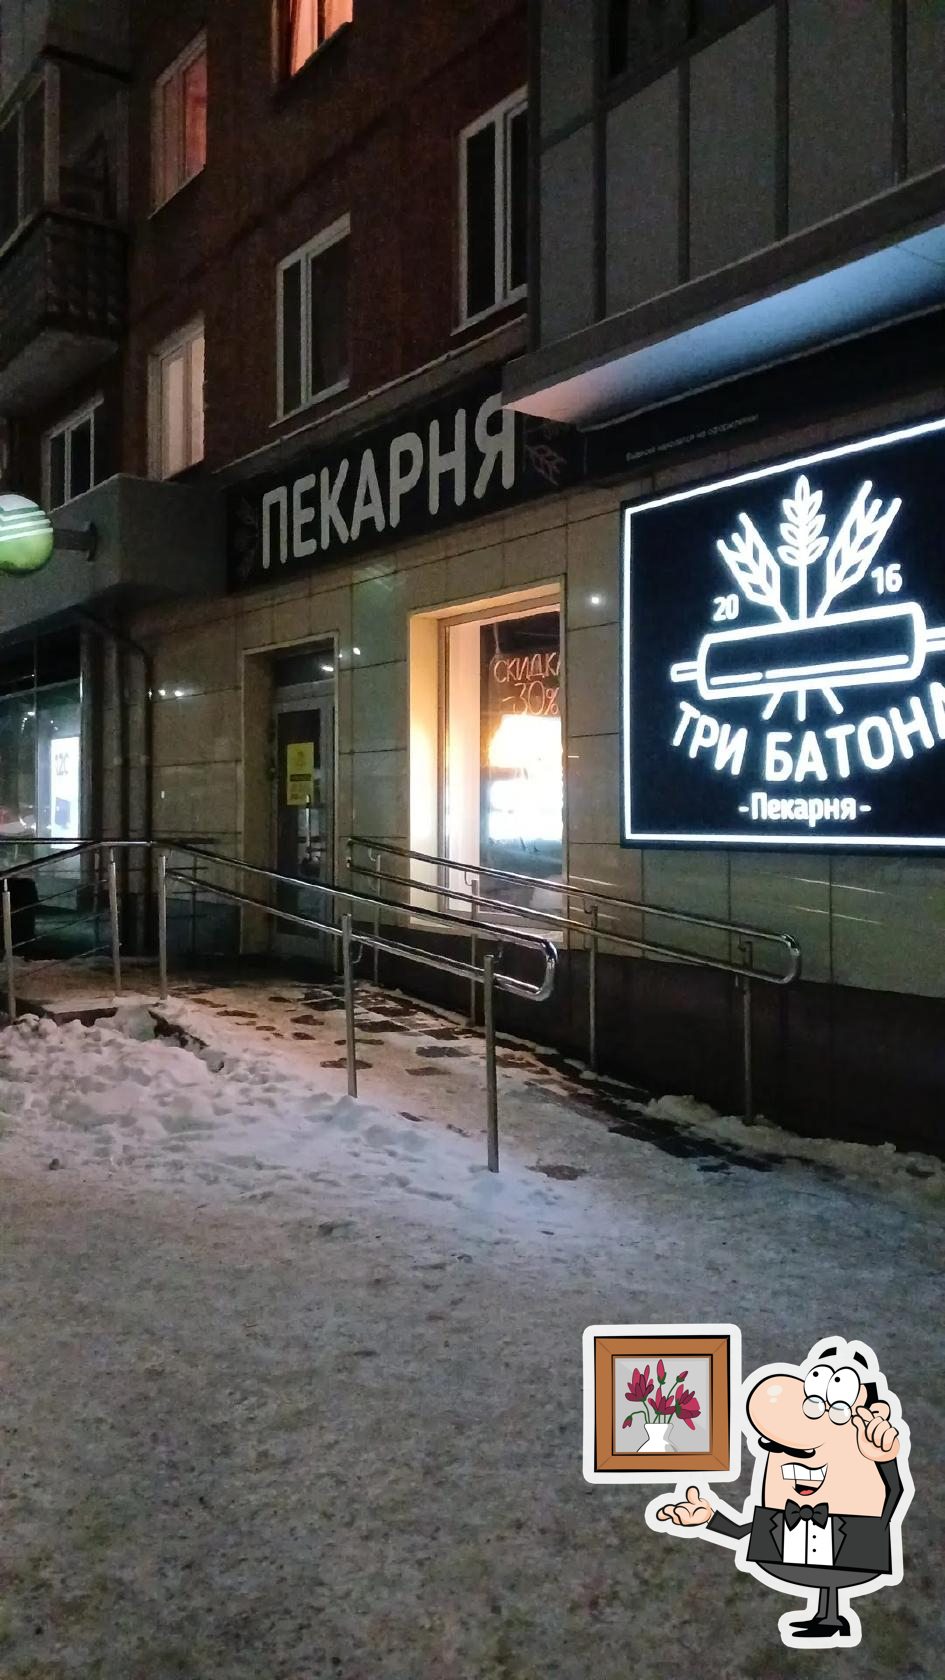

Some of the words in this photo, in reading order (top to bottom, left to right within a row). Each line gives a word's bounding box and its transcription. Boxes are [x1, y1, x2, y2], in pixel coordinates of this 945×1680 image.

[262, 391, 515, 569] ПЕКАРНЯ
[712, 593, 739, 622] 20
[871, 563, 902, 594] 16
[502, 680, 559, 716] -30%
[671, 700, 748, 776] ТРИ
